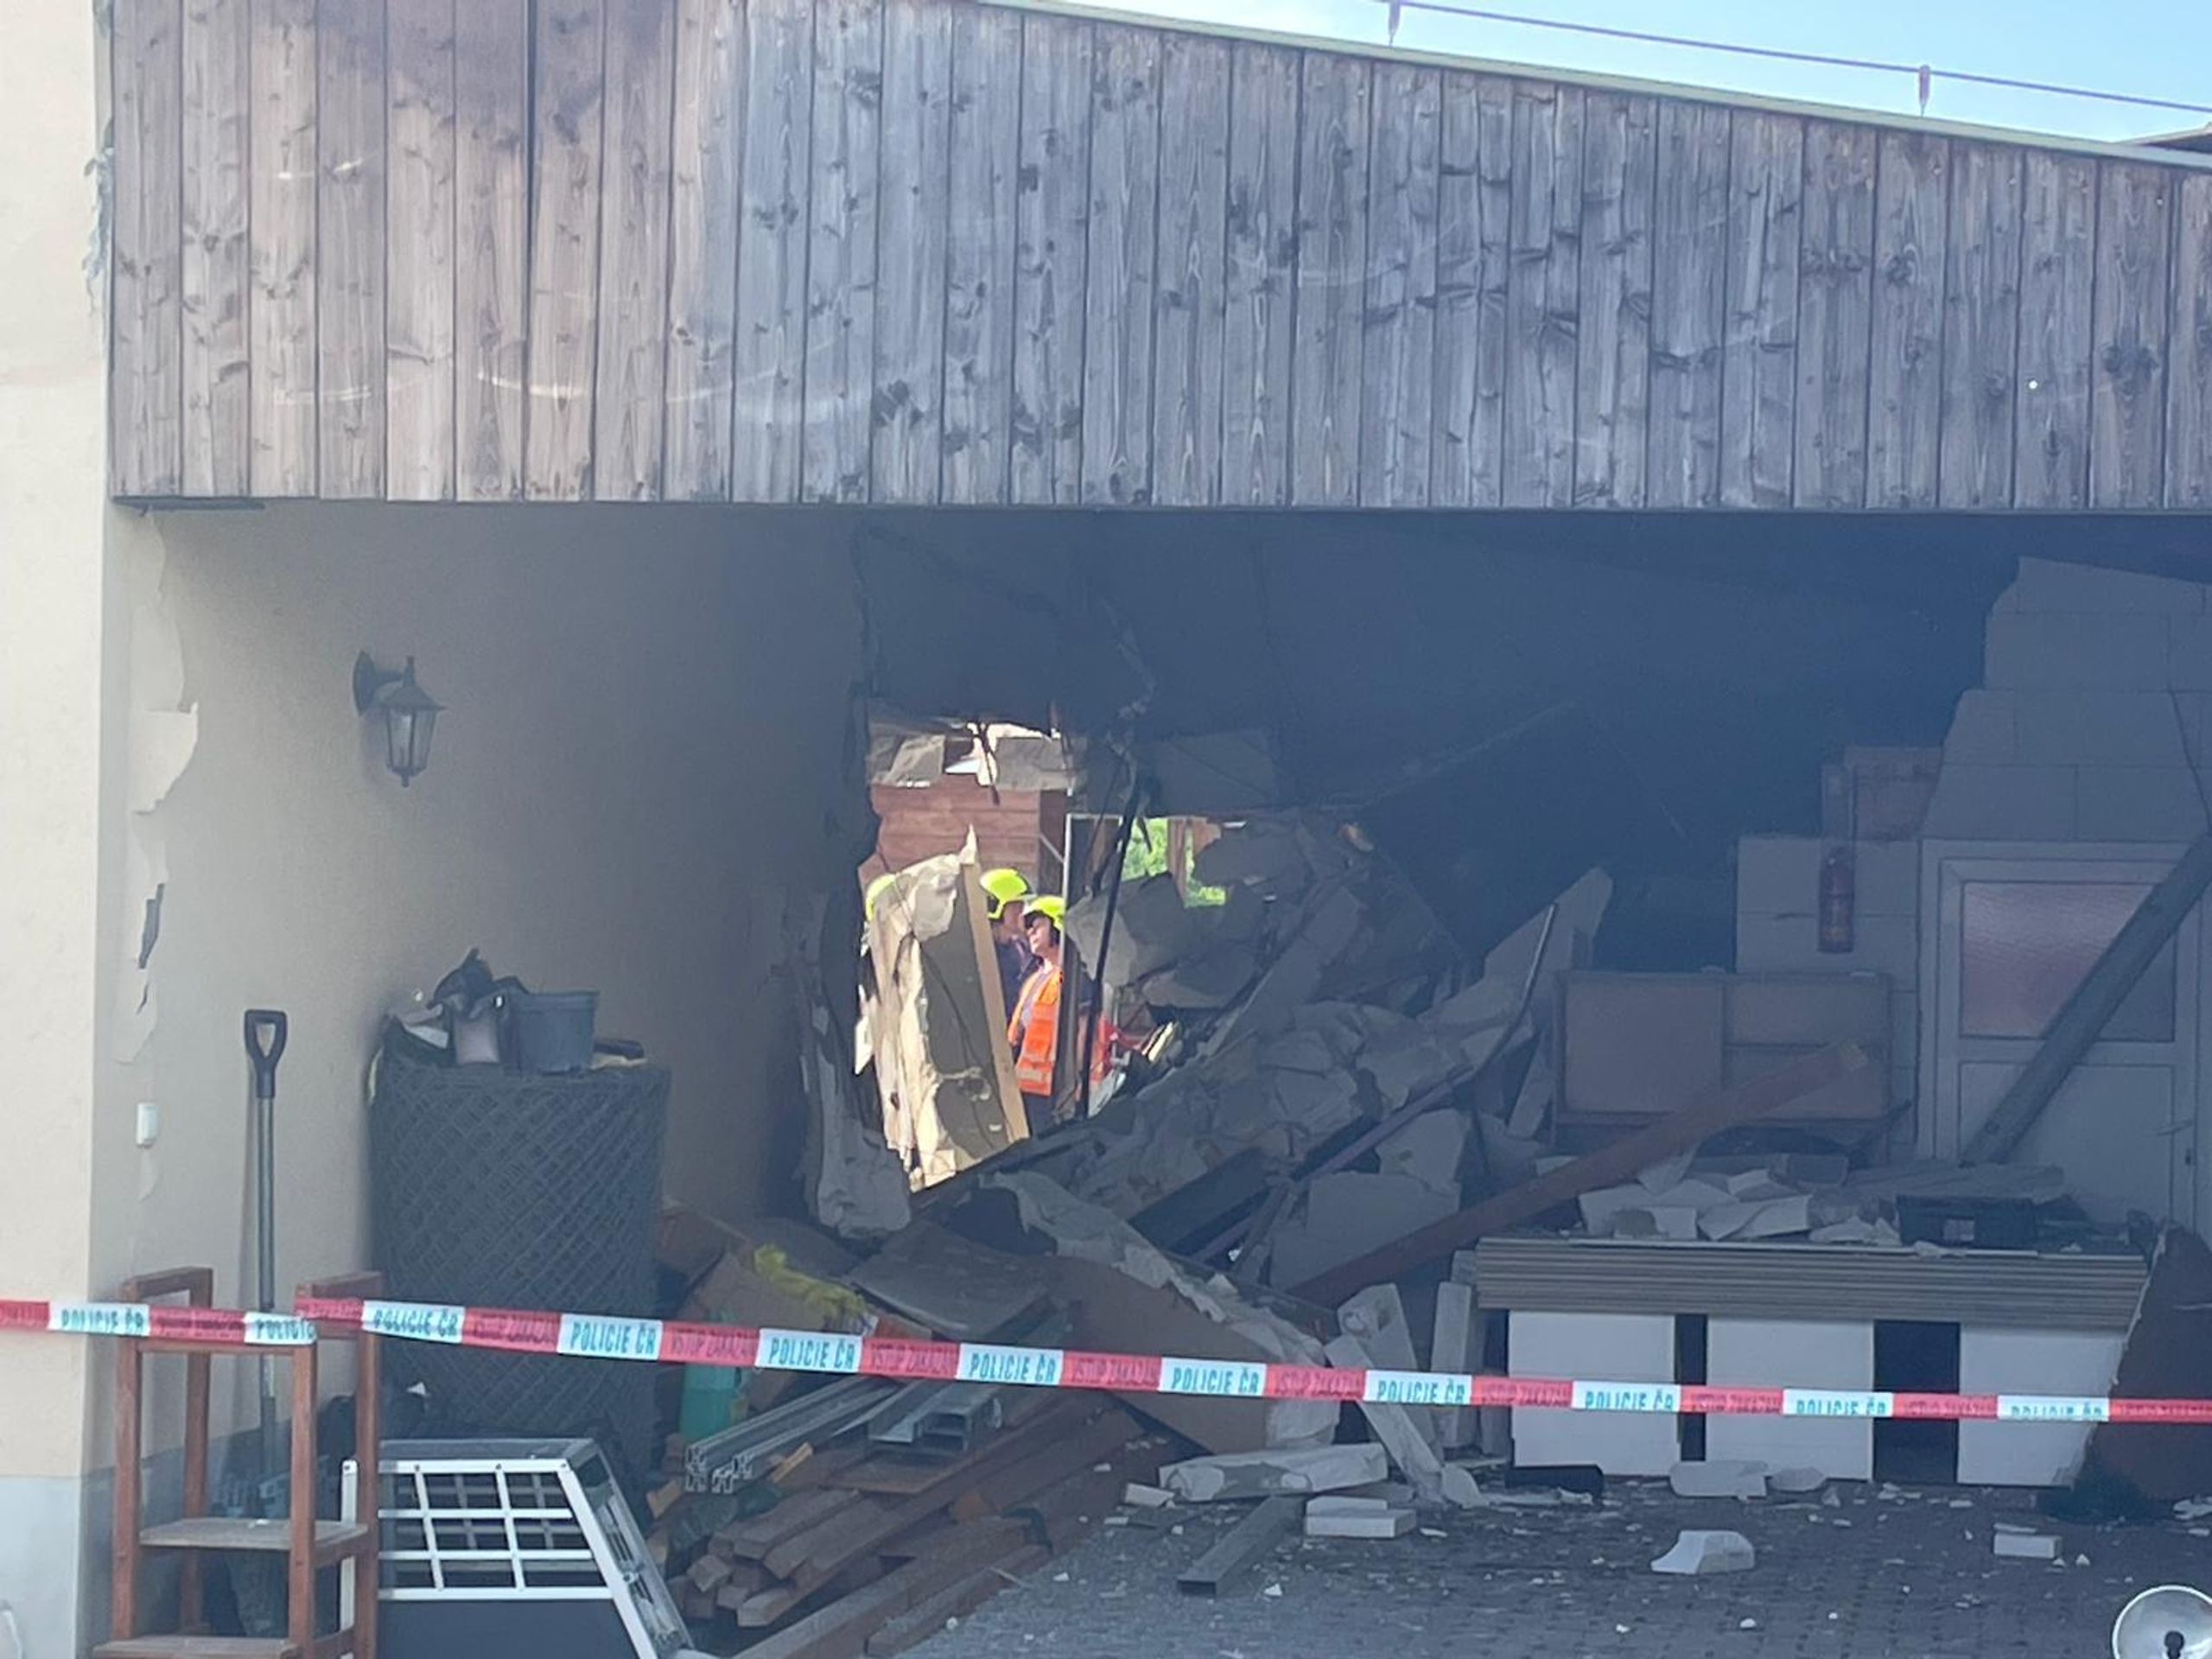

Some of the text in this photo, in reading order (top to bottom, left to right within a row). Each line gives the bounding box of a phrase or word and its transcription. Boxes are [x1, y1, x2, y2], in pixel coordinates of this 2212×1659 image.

[374, 1308, 432, 1333] POLICIE
[569, 1321, 630, 1354] POLICIE
[768, 1337, 827, 1367] POLICIE
[969, 1351, 1030, 1381] POLICIE
[1171, 1365, 1234, 1393] POLICIE
[1377, 1379, 1439, 1404] POLICIE
